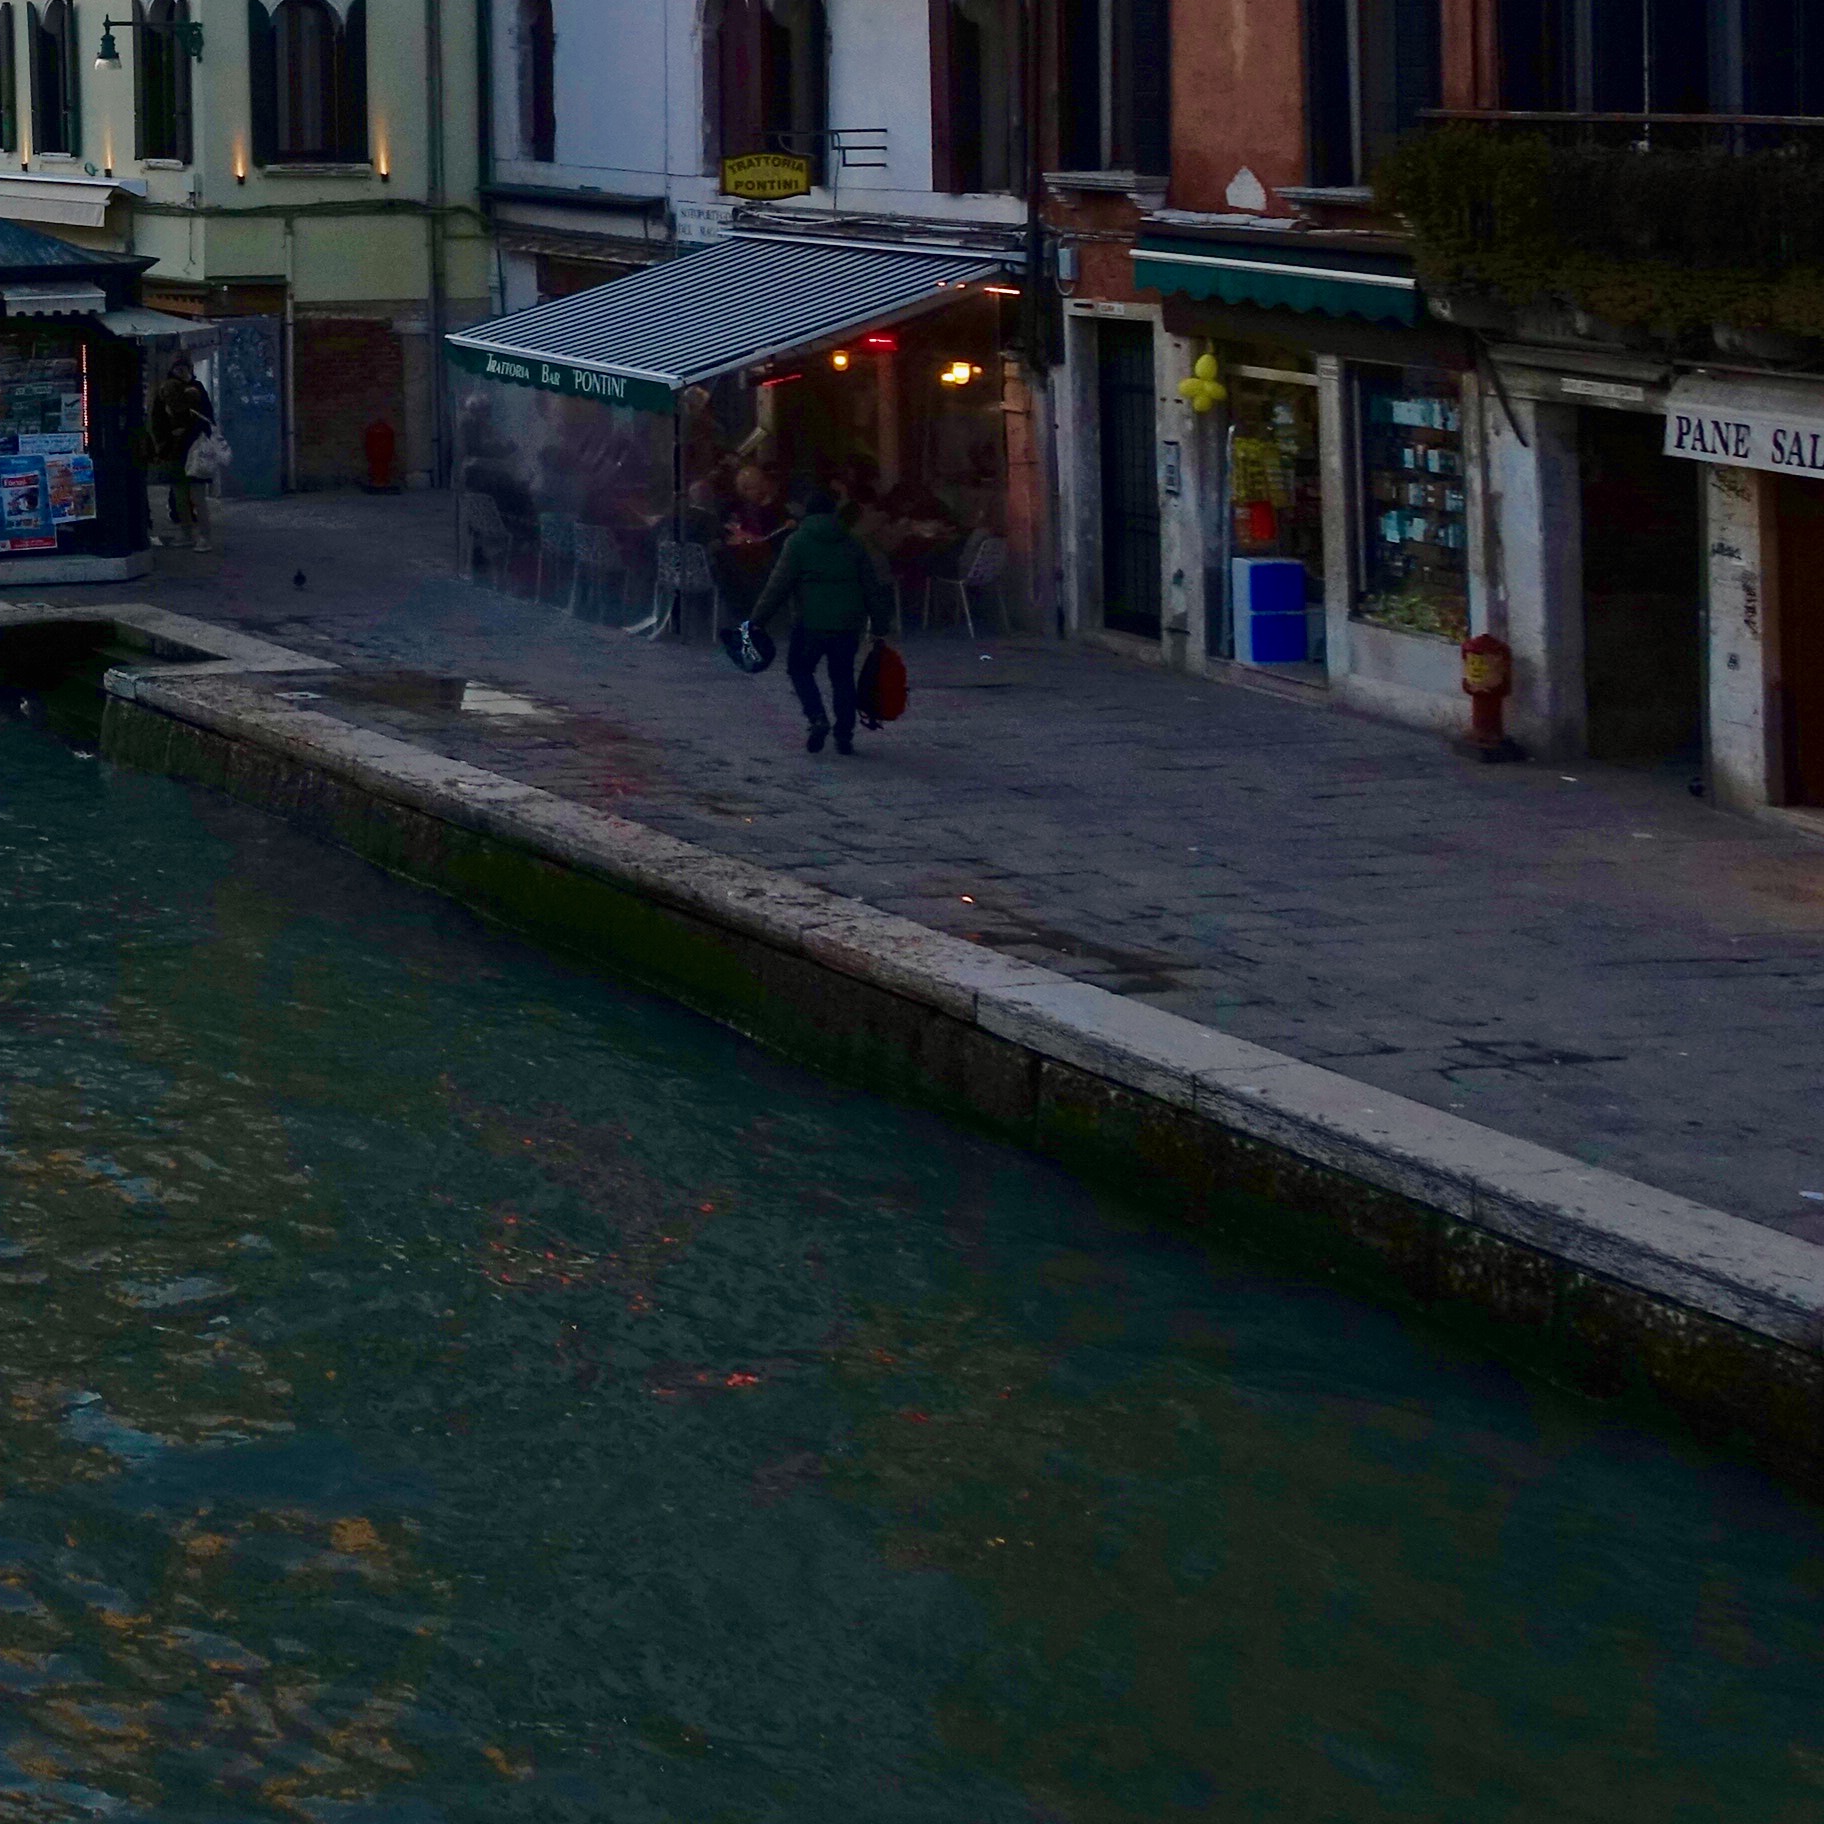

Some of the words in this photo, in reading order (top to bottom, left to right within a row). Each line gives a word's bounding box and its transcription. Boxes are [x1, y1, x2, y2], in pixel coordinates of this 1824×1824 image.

[727, 156, 805, 175] TRATTORIA
[734, 179, 799, 191] PONTINI
[1674, 415, 1751, 458] PANE
